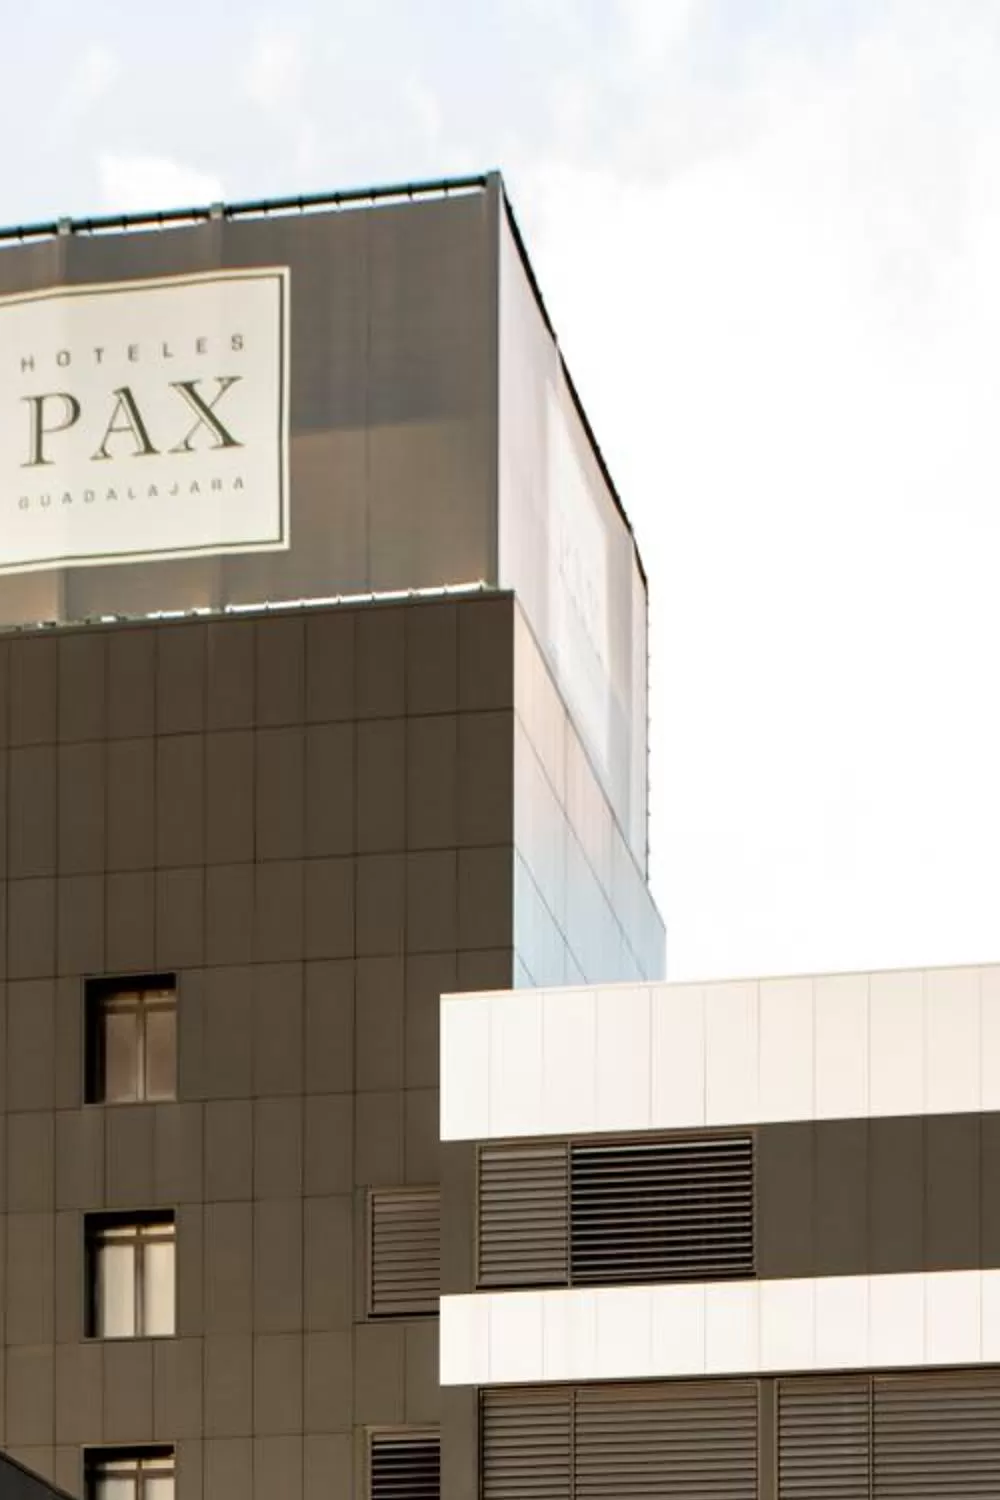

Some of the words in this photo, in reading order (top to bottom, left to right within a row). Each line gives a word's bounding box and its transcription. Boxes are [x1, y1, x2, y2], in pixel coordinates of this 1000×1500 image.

[20, 333, 244, 373] HOTELES
[20, 376, 244, 468] PAX
[18, 476, 244, 510] GUADALAJARA
